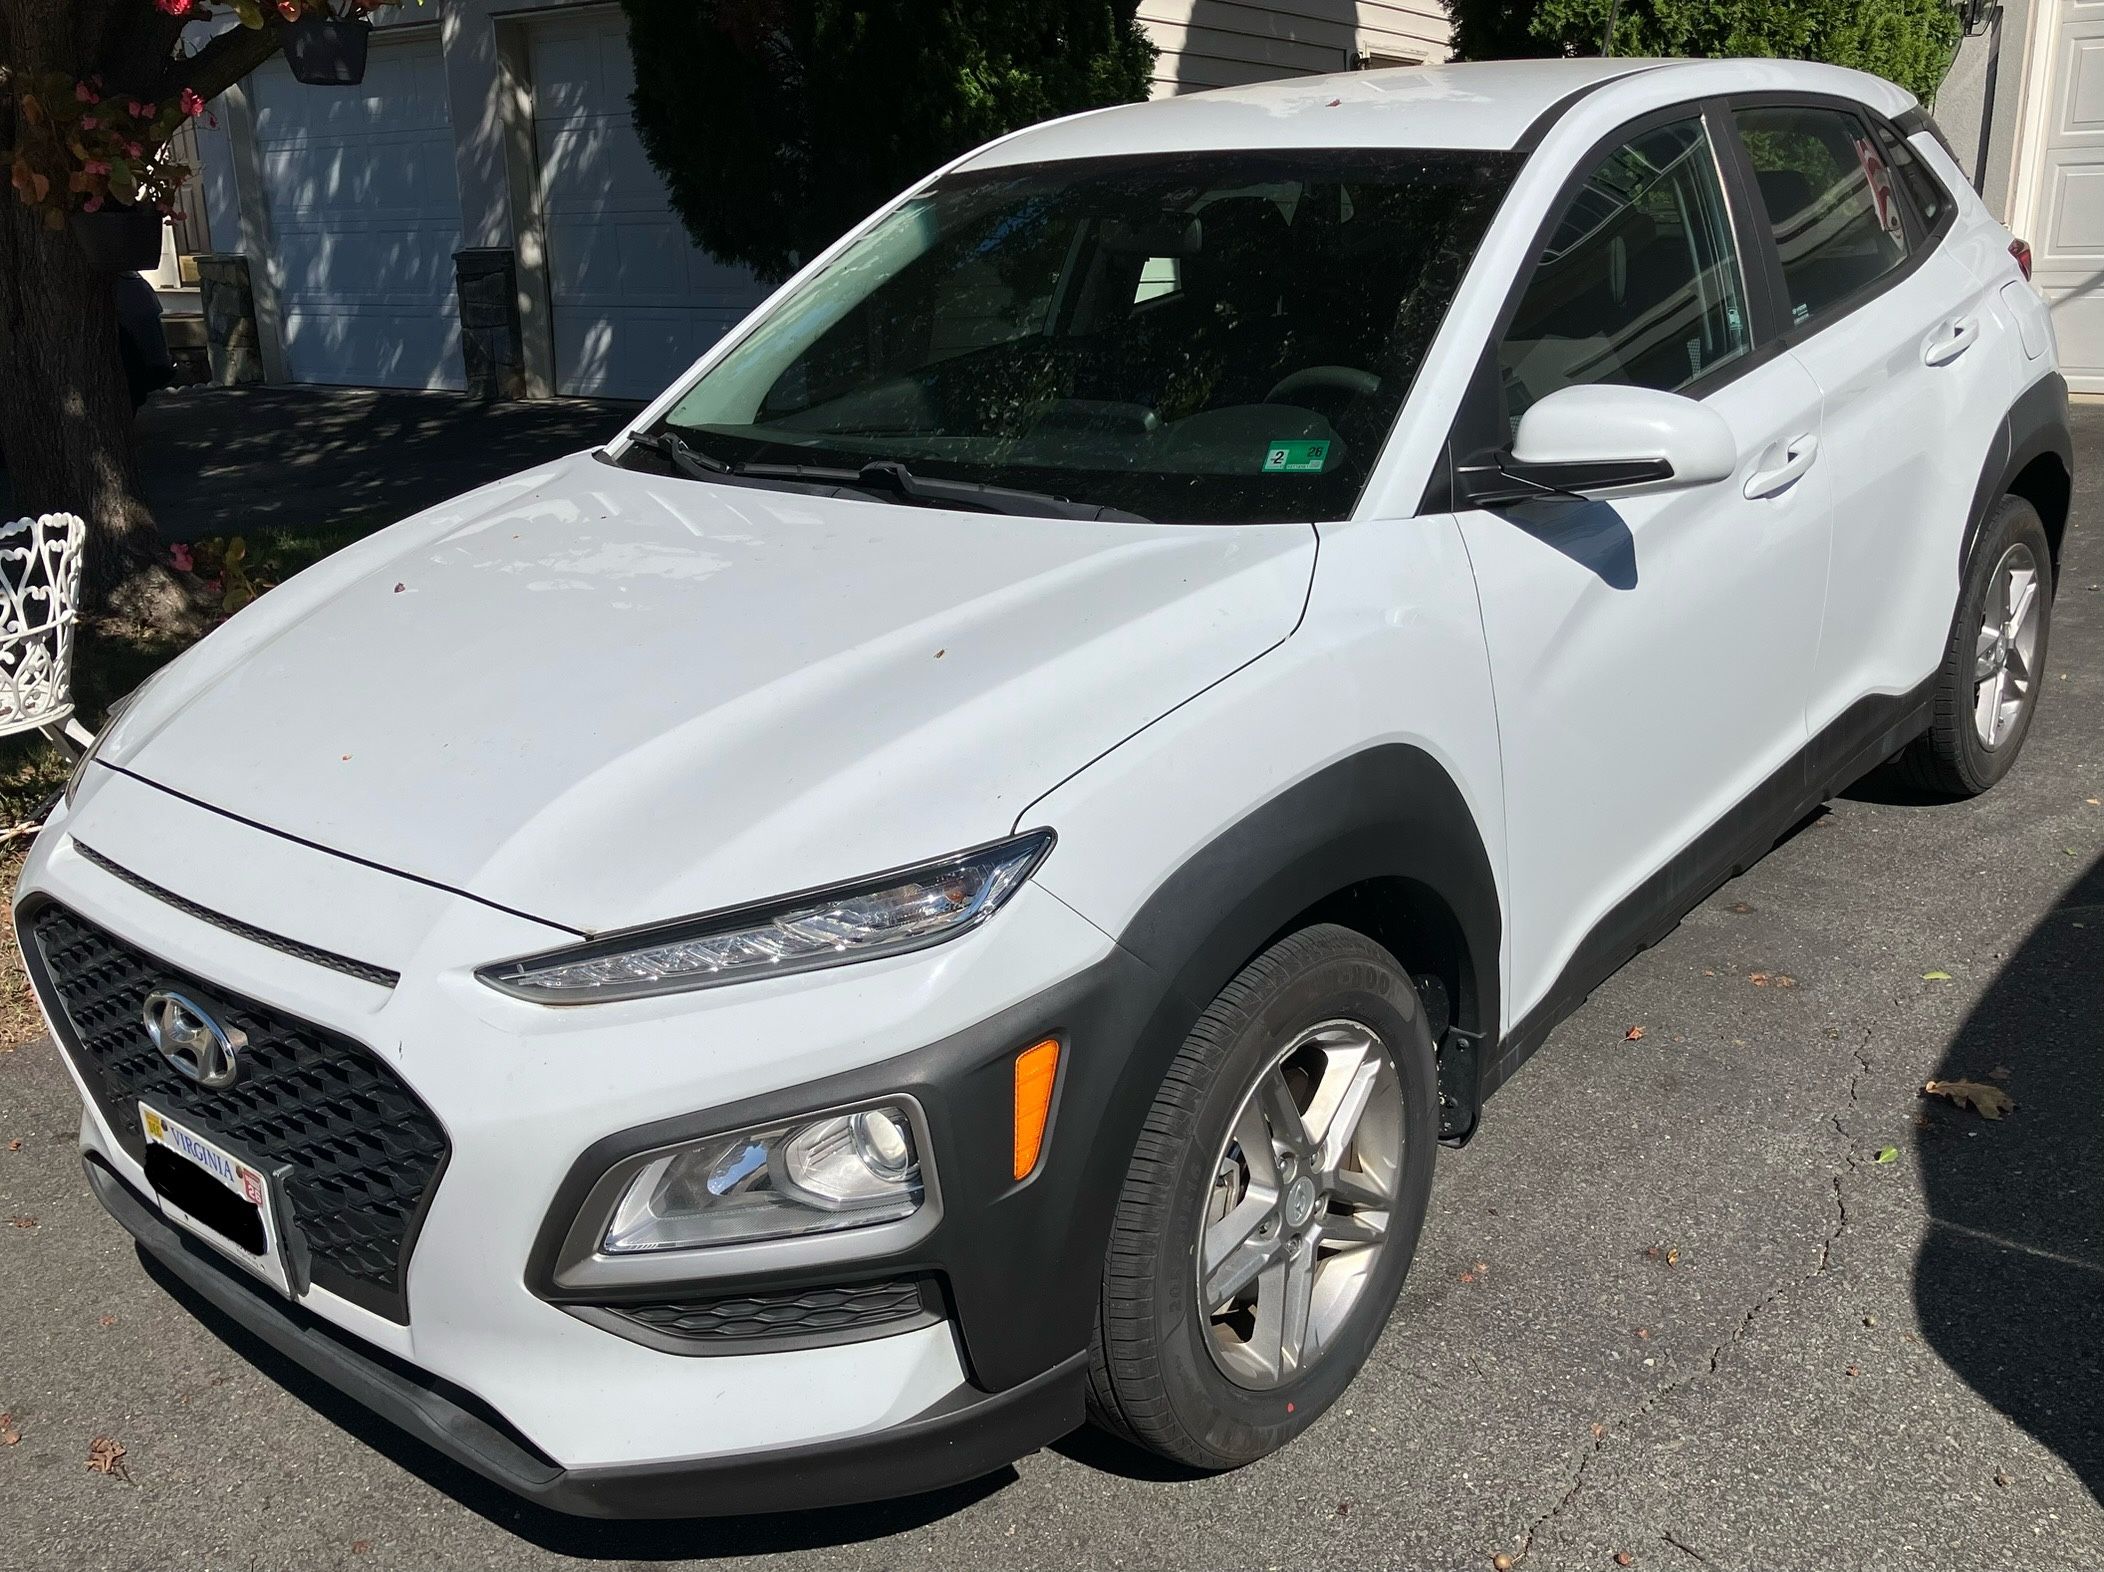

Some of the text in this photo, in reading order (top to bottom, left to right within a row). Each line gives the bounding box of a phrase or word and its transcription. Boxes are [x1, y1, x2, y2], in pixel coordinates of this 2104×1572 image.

[1273, 450, 1285, 464] 2
[1307, 446, 1323, 457] 26
[170, 1126, 235, 1183] VIRGINIA
[248, 1184, 262, 1204] 26
